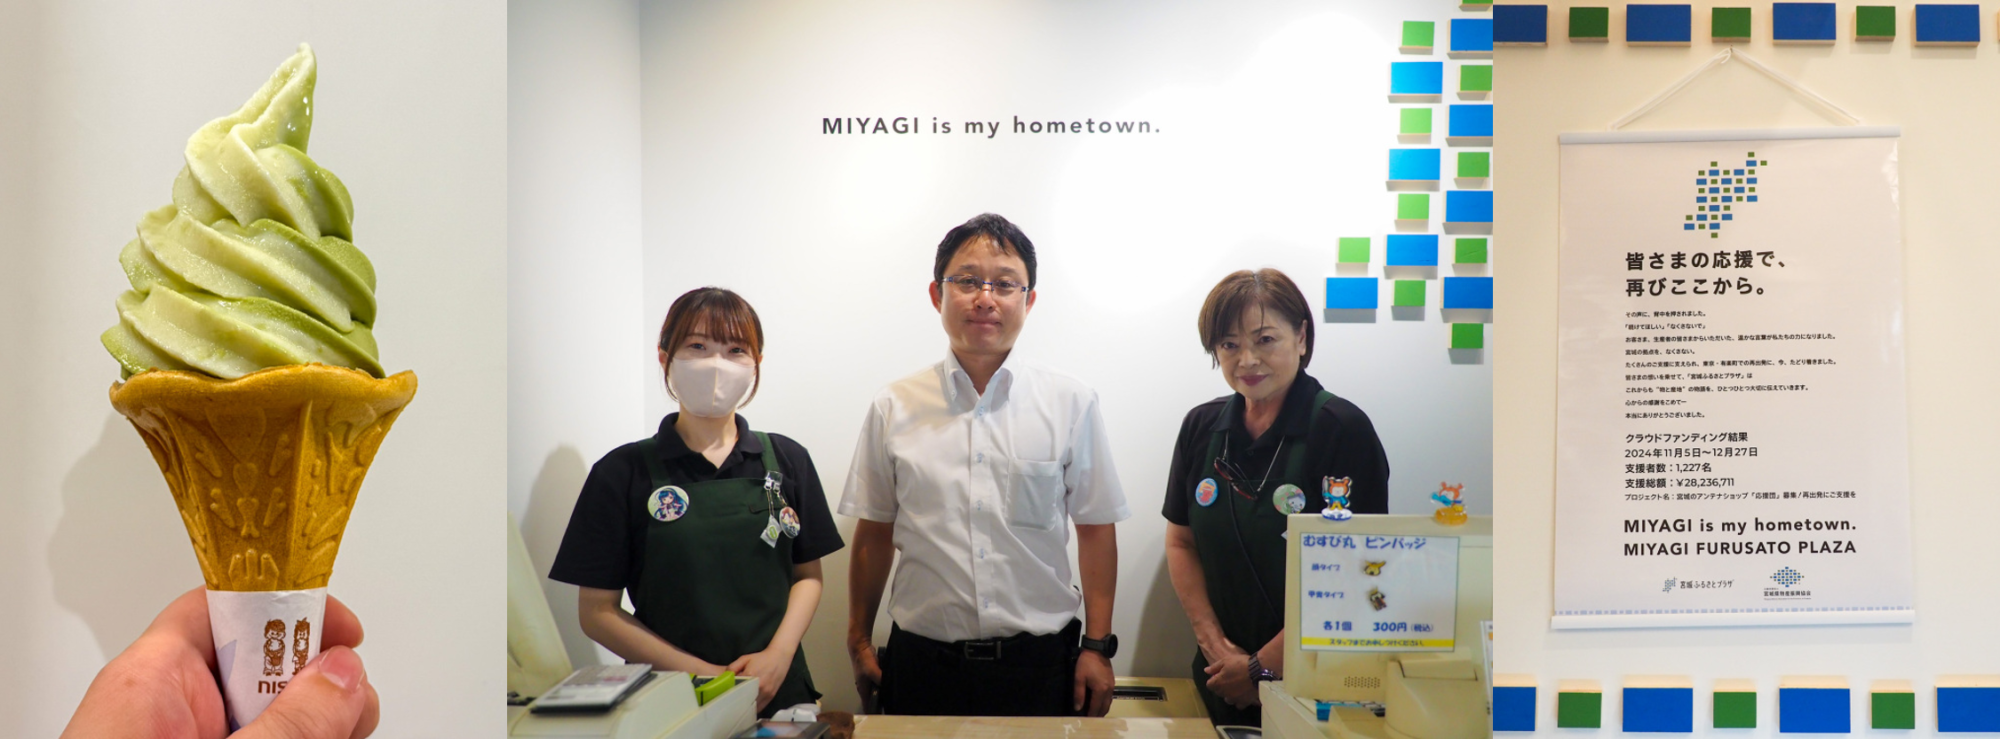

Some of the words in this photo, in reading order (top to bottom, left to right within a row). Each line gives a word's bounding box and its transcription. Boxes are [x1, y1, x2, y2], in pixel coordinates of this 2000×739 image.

[822, 116, 919, 135] MIYAGI
[932, 116, 952, 135] is
[964, 121, 1001, 140] my
[1012, 114, 1162, 134] hometown.
[1624, 249, 1787, 272] 皆さまの応援で、
[1624, 276, 1767, 298] 再びここから。
[1625, 431, 1749, 444] クラウドファンディング結果
[1623, 518, 1692, 534] MIYAGI
[1699, 517, 1715, 533] is
[1721, 521, 1748, 536] my
[1754, 516, 1857, 532] hometown.
[1303, 534, 1357, 549] むすび丸
[1623, 541, 1690, 557] MIYAGI
[1695, 540, 1792, 556] FURUSATO
[1798, 540, 1857, 555] PLAZA
